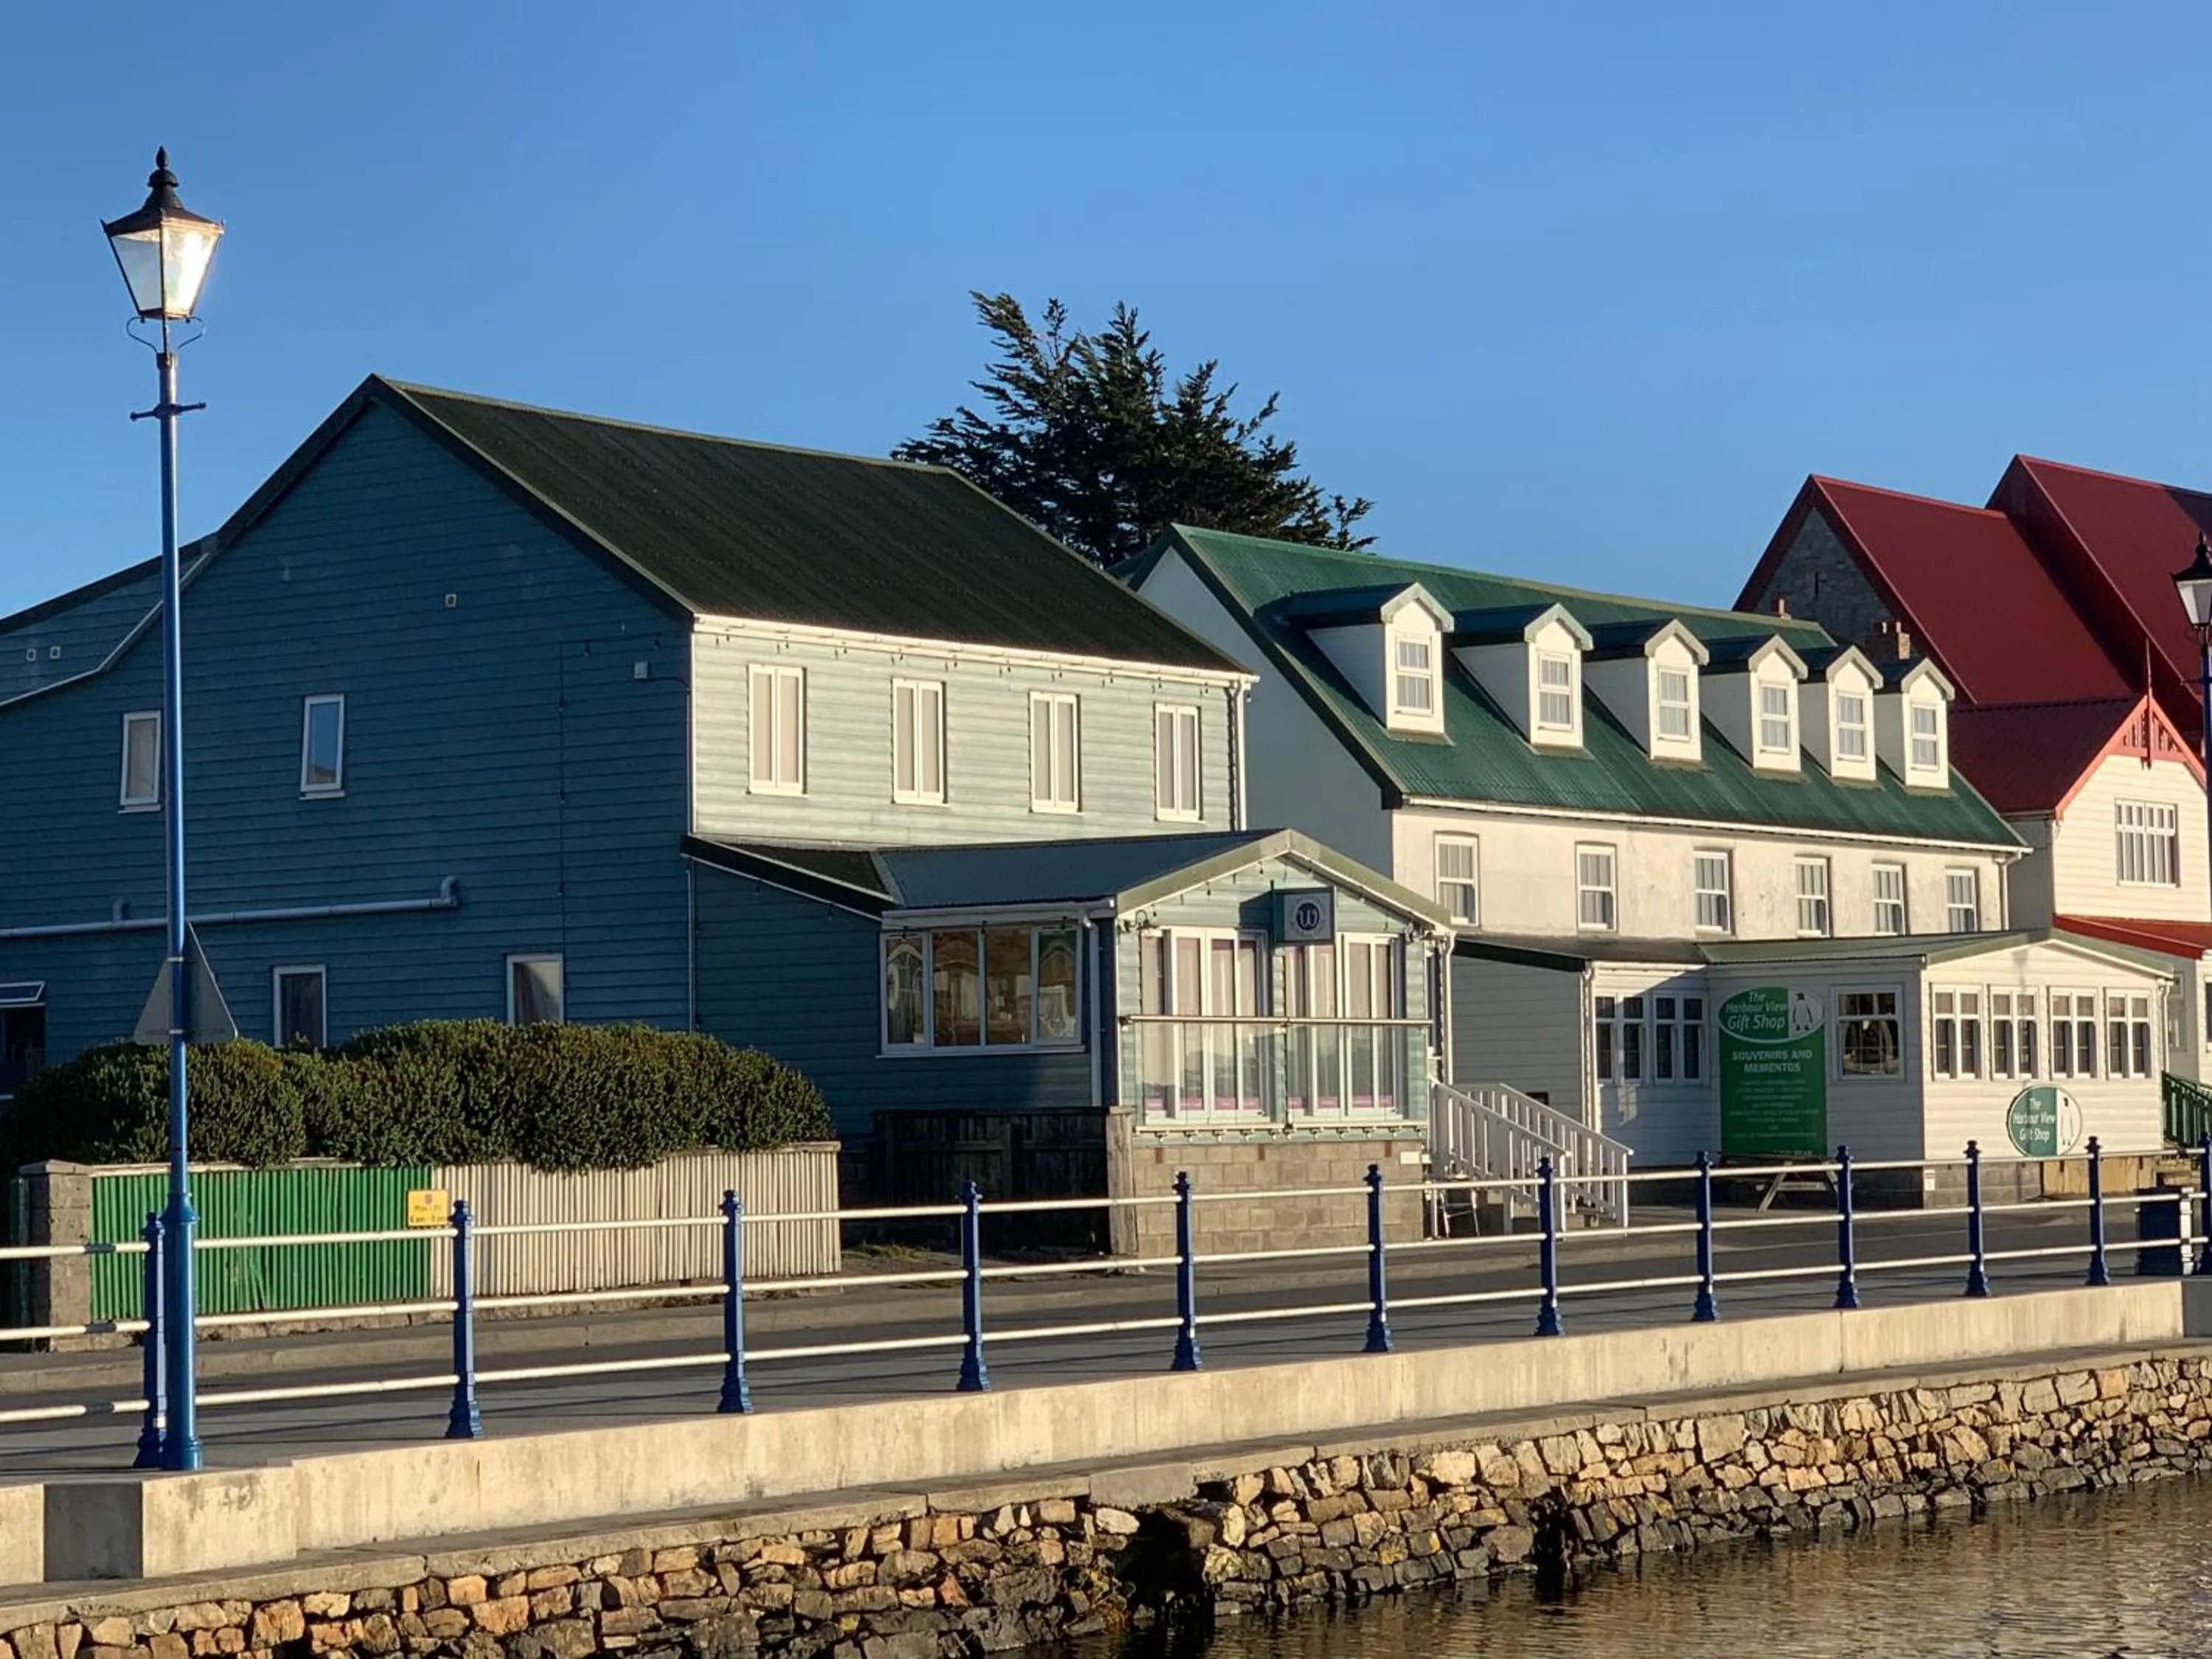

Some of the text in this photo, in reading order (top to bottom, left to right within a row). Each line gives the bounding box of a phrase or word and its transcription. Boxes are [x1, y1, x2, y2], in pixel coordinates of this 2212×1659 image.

[1748, 991, 1767, 1003] The
[1725, 999, 1787, 1013] Harbour View
[1728, 1014, 1786, 1034] Gift Shop
[1731, 1049, 1813, 1061] SOUVENIRS AND
[1744, 1062, 1801, 1073] MEMENTOS
[2029, 1097, 2042, 1110] The
[2040, 1111, 2056, 1124] View
[2034, 1127, 2051, 1144] Shop
